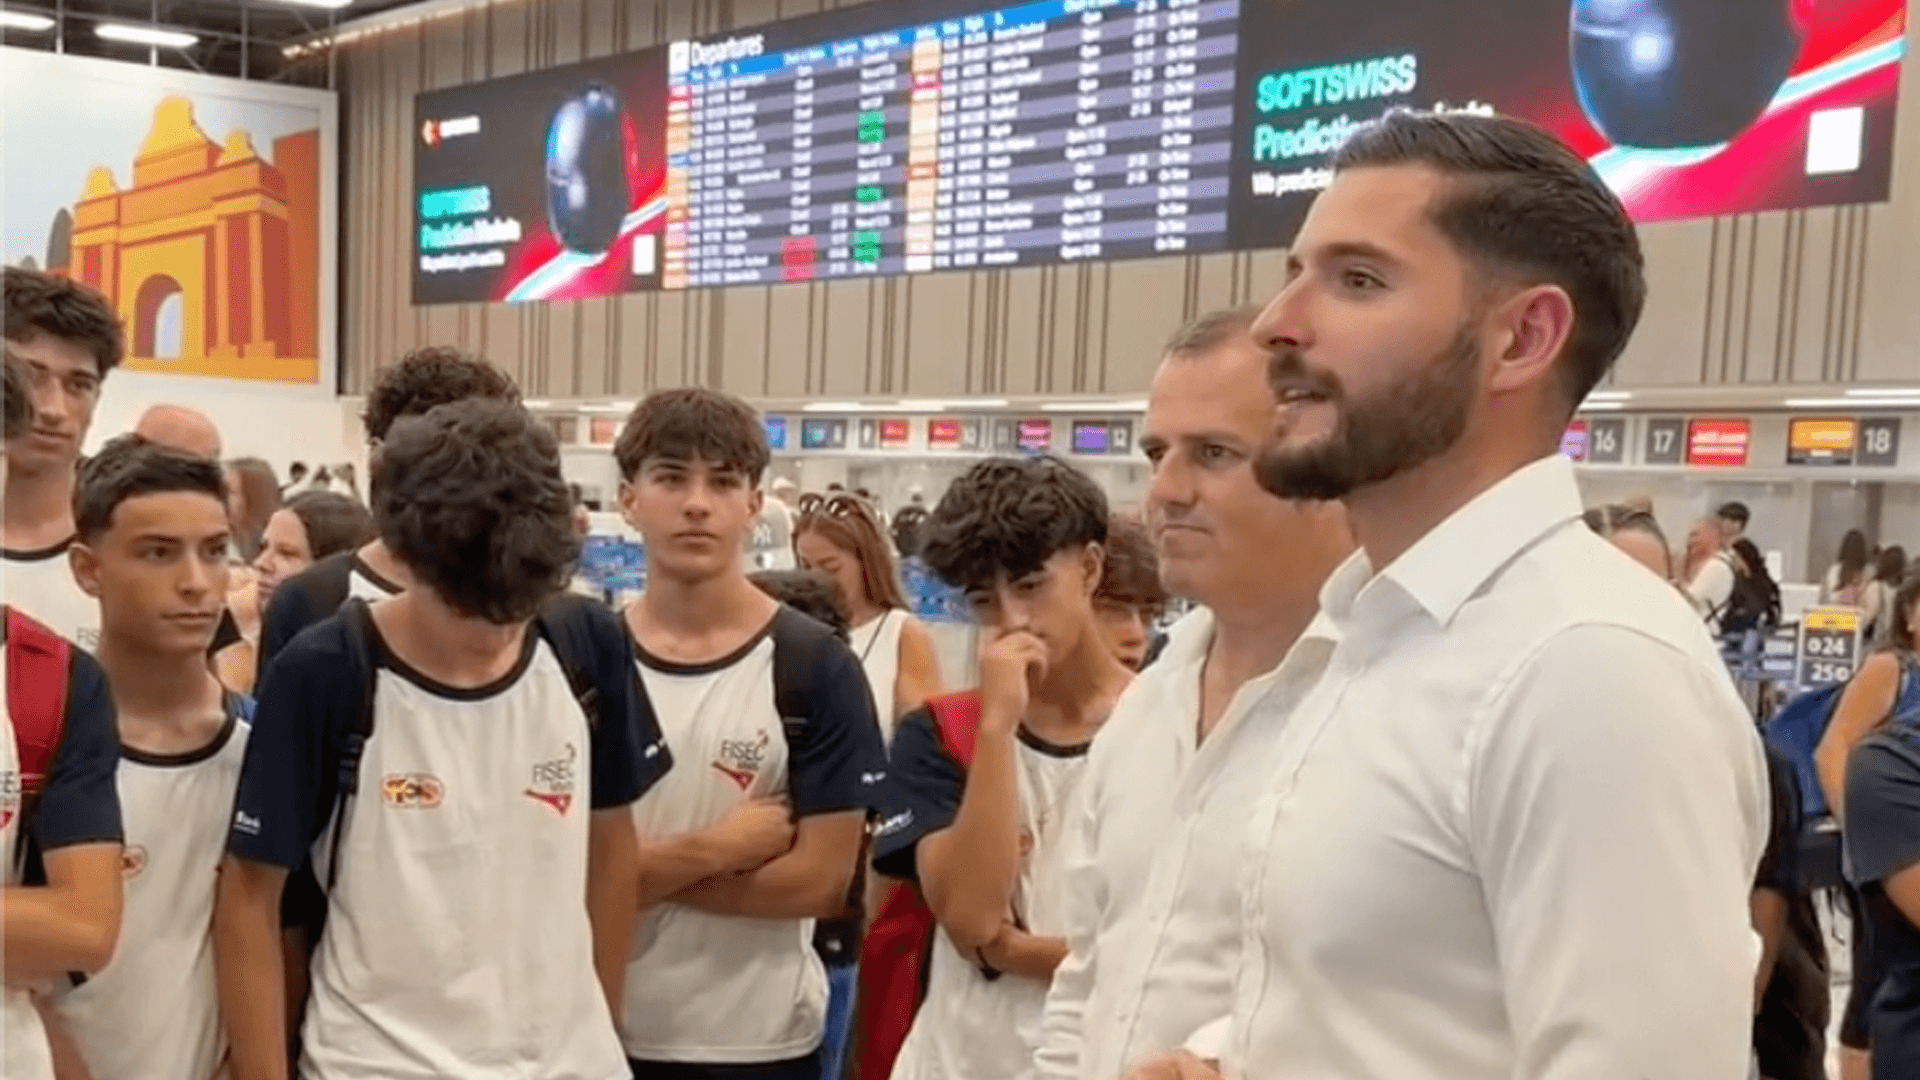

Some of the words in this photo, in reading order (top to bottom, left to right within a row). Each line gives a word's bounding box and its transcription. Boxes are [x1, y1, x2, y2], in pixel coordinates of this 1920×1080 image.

[1256, 54, 1417, 112] SOFTSWISS
[1254, 115, 1358, 161] Predicti
[1594, 427, 1616, 454] 16
[1653, 429, 1675, 454] 17
[1865, 427, 1891, 454] 18
[1822, 636, 1846, 656] 24
[1811, 662, 1833, 682] 25
[721, 739, 766, 762] FISEC
